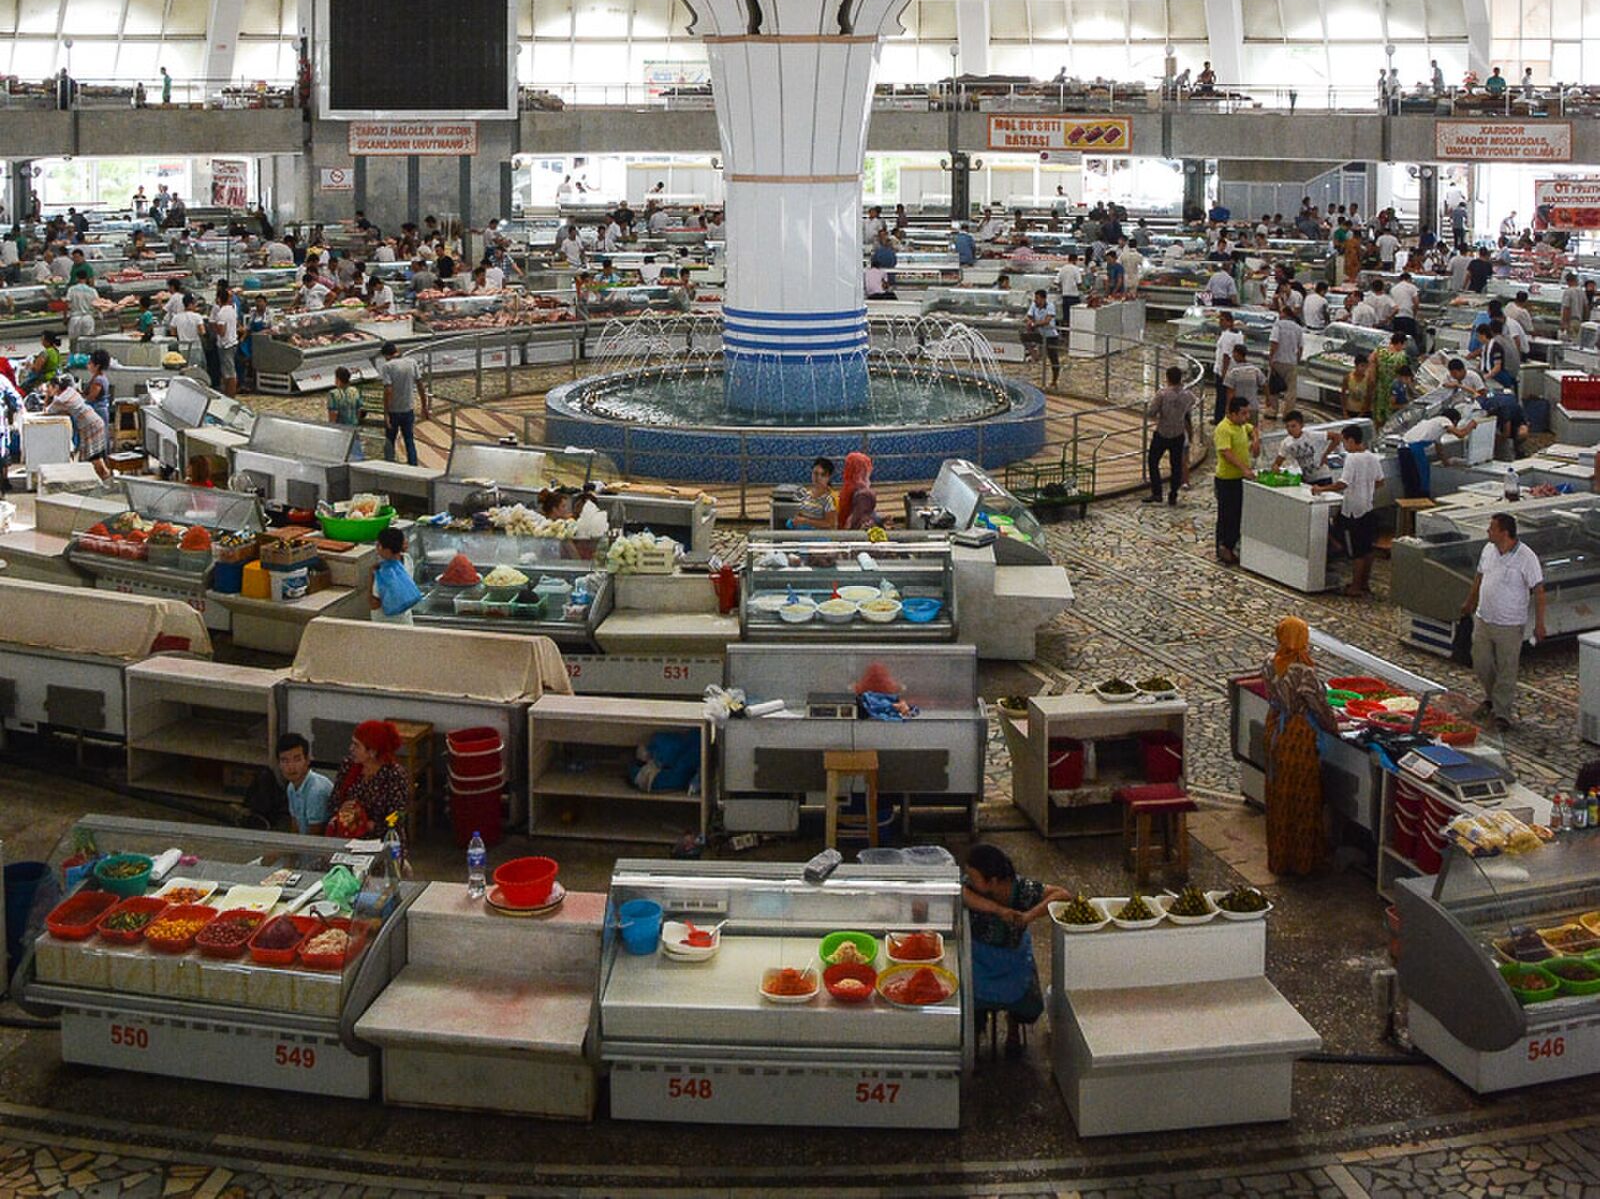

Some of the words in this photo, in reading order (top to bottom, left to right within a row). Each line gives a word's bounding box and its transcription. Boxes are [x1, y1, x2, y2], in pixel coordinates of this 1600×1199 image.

[663, 666, 689, 679] 531
[110, 1024, 149, 1049] 550
[274, 1044, 316, 1069] 549
[1527, 1036, 1565, 1061] 546
[668, 1078, 713, 1099] 548
[855, 1082, 901, 1103] 547
